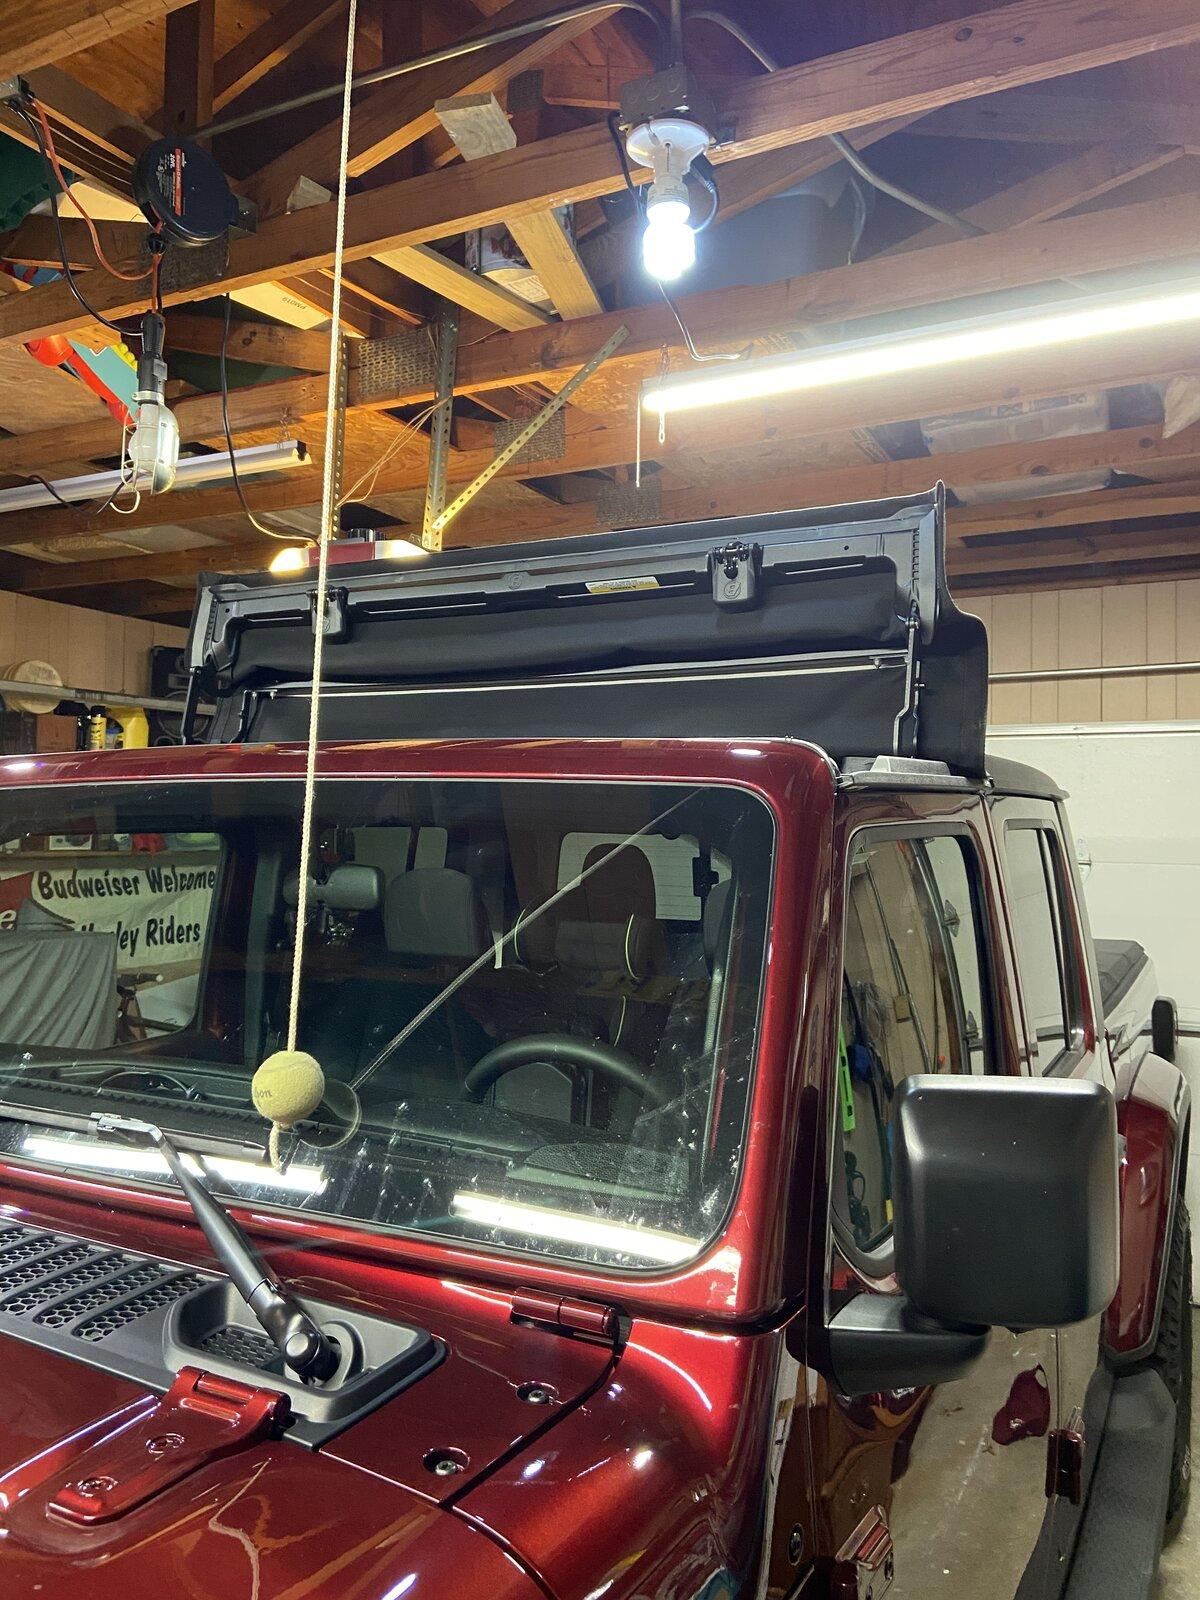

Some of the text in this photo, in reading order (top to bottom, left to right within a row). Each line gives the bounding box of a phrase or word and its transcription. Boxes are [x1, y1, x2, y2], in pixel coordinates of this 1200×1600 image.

[38, 864, 215, 900] Budweiser Welcome
[146, 915, 200, 947] Riders
